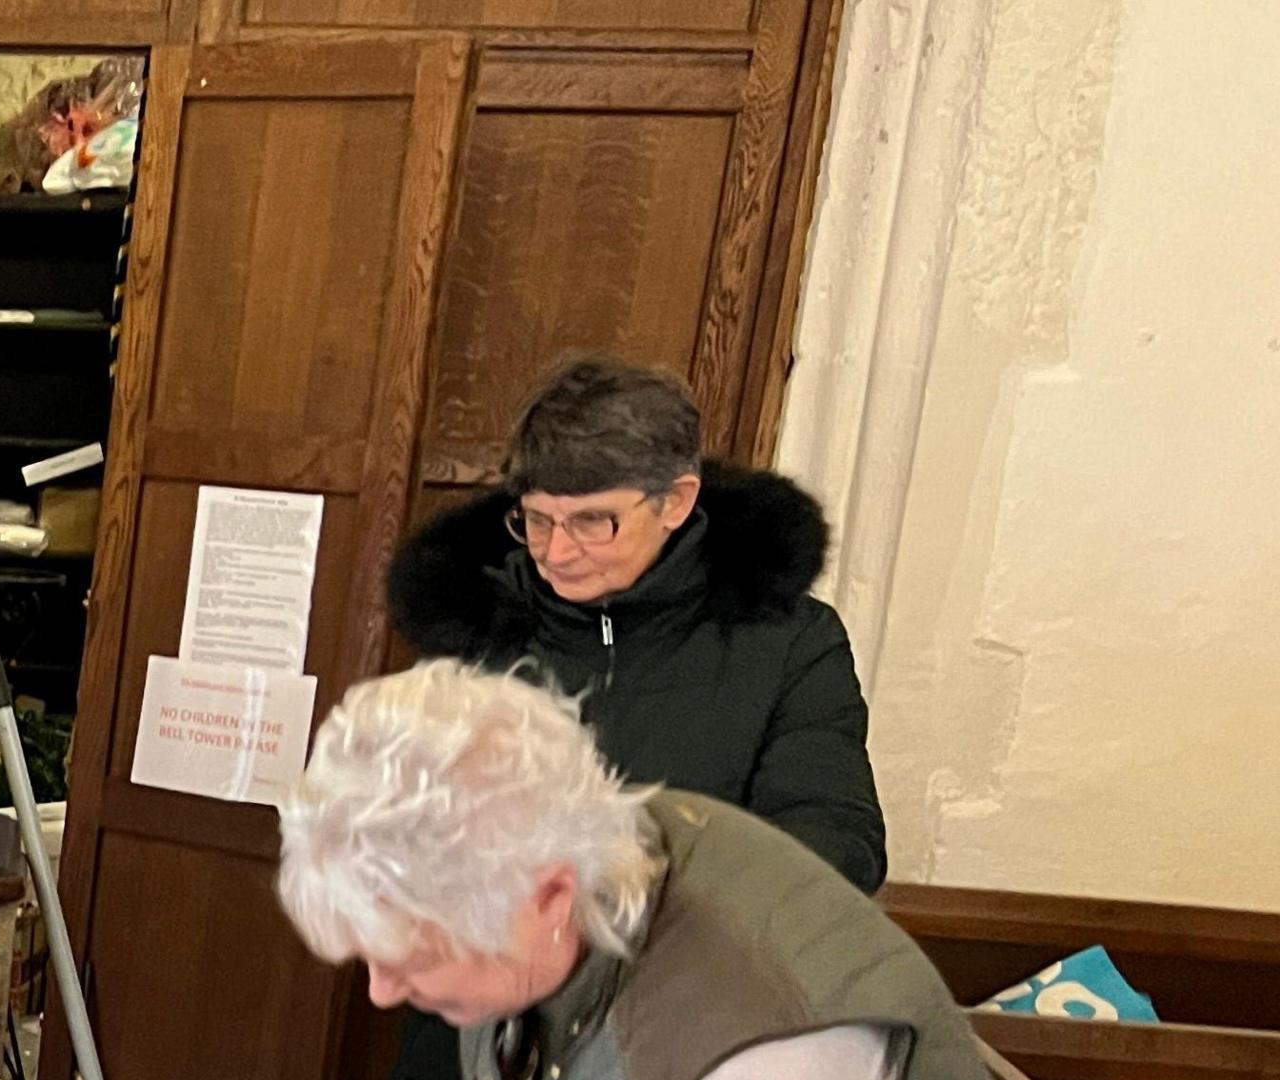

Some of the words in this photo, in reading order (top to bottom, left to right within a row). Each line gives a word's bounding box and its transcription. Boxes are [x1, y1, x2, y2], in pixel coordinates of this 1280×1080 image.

[160, 706, 178, 721] NO
[180, 708, 239, 729] CHILDREN
[259, 720, 285, 735] THE
[159, 725, 185, 741] BELL
[187, 728, 232, 749] TOWER
